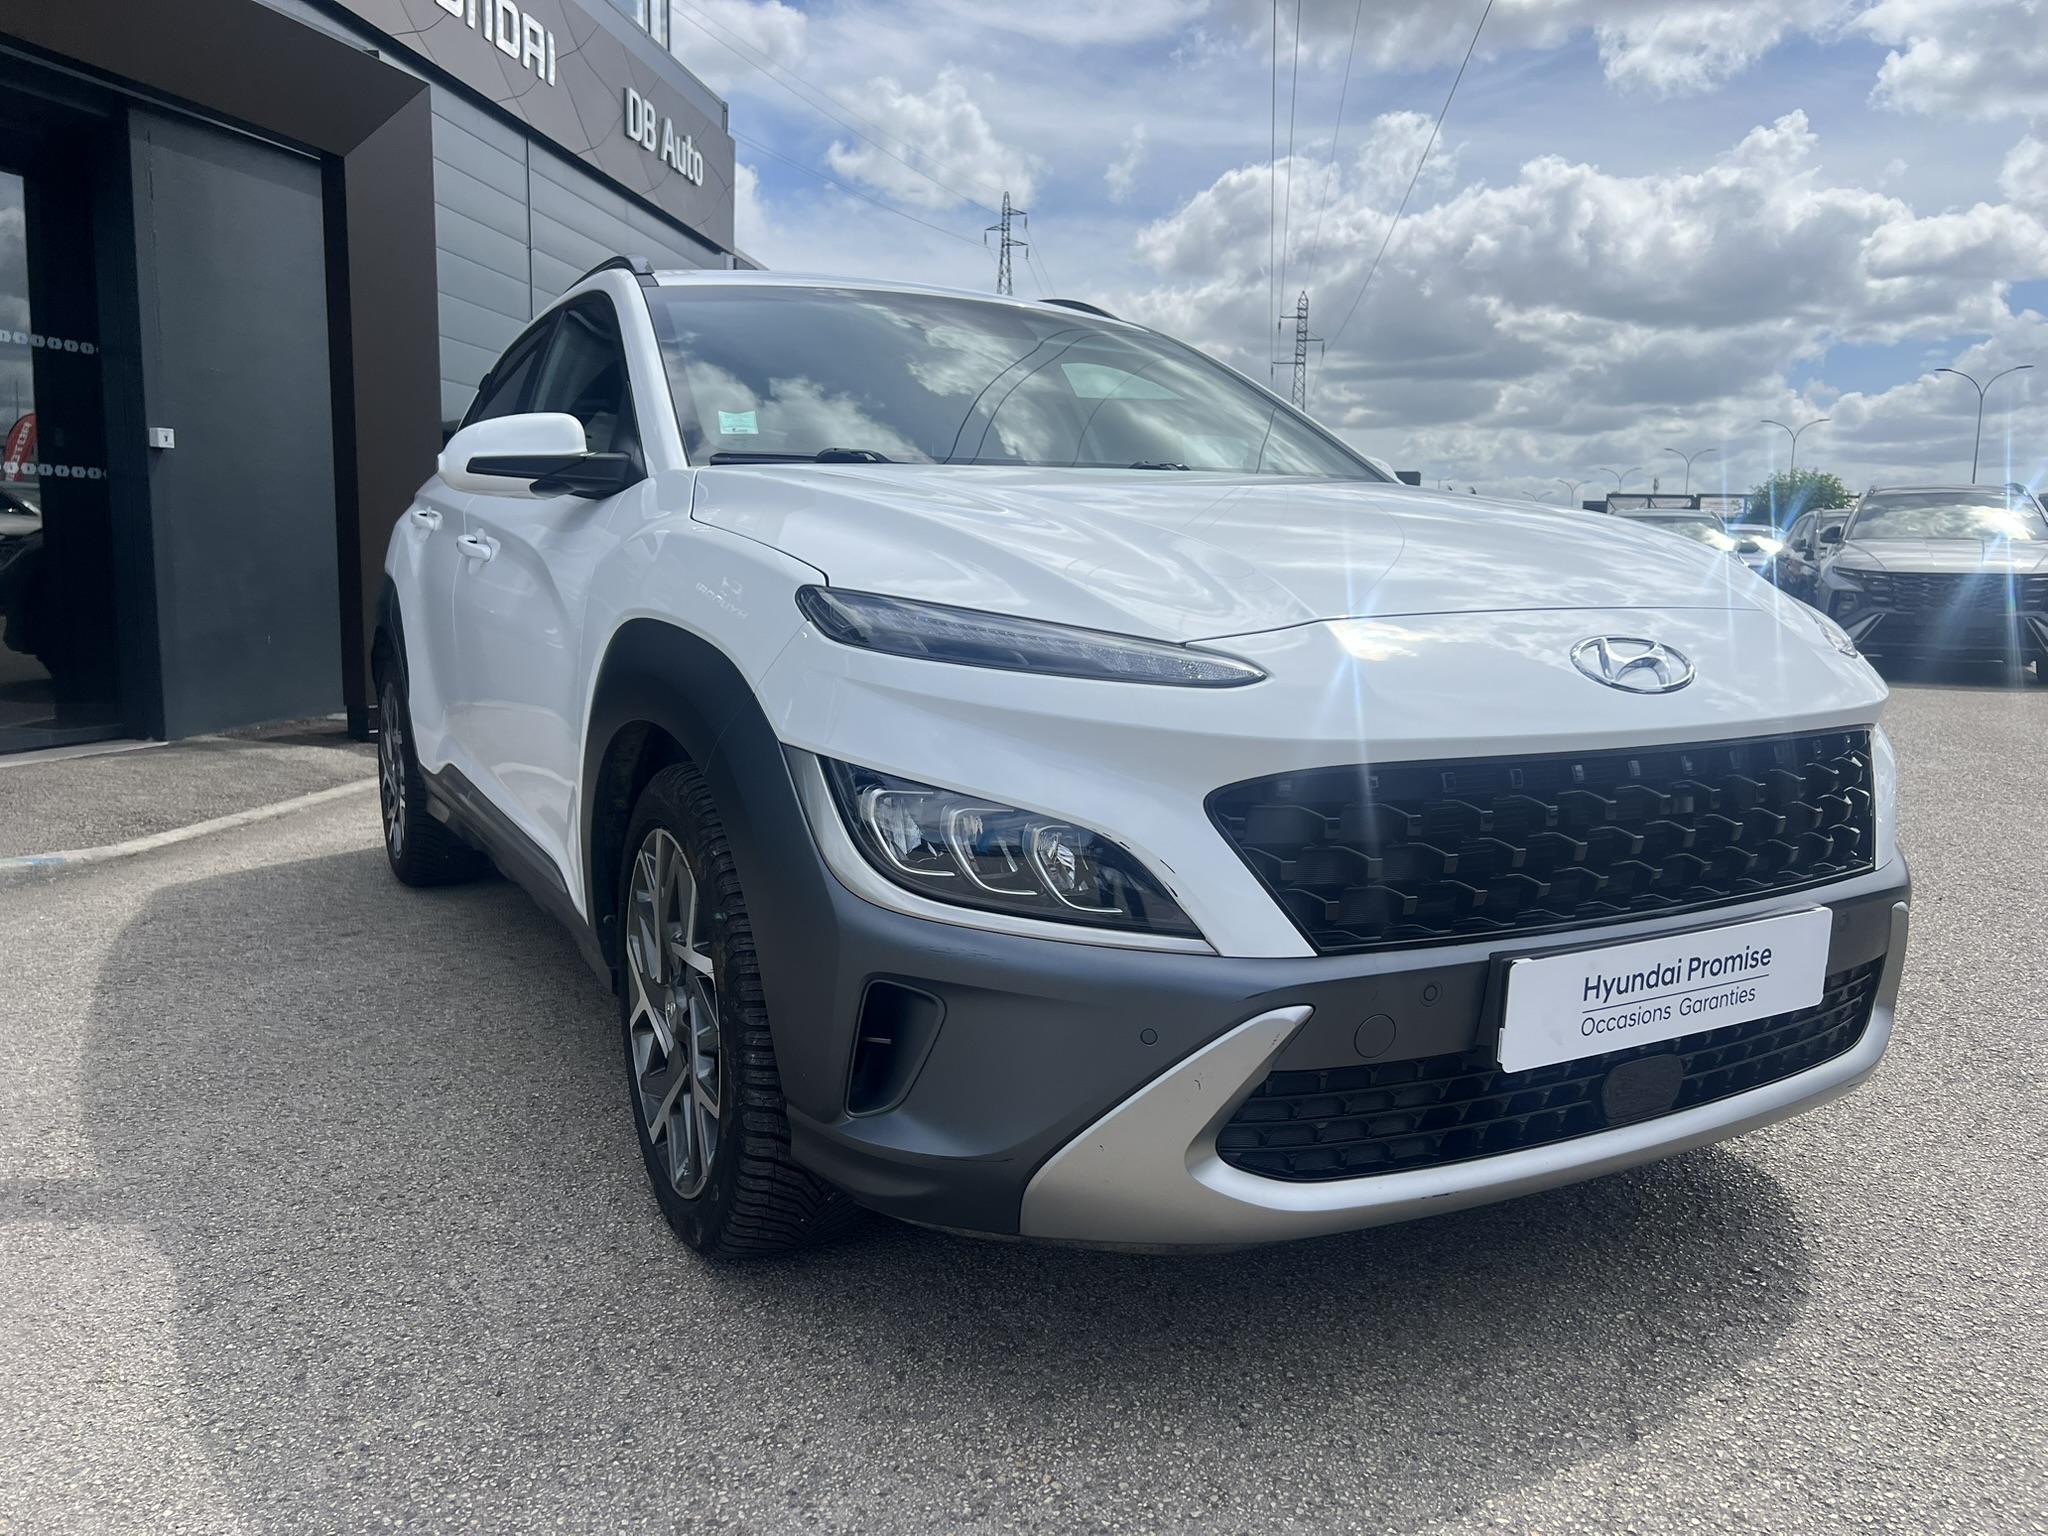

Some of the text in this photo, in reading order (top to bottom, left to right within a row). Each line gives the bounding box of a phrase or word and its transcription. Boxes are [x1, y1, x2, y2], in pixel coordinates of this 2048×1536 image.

[626, 87, 704, 187] DB Auto
[1583, 945, 1772, 1004] Hyundai Promise
[1581, 986, 1756, 1036] Occasions Garanties
